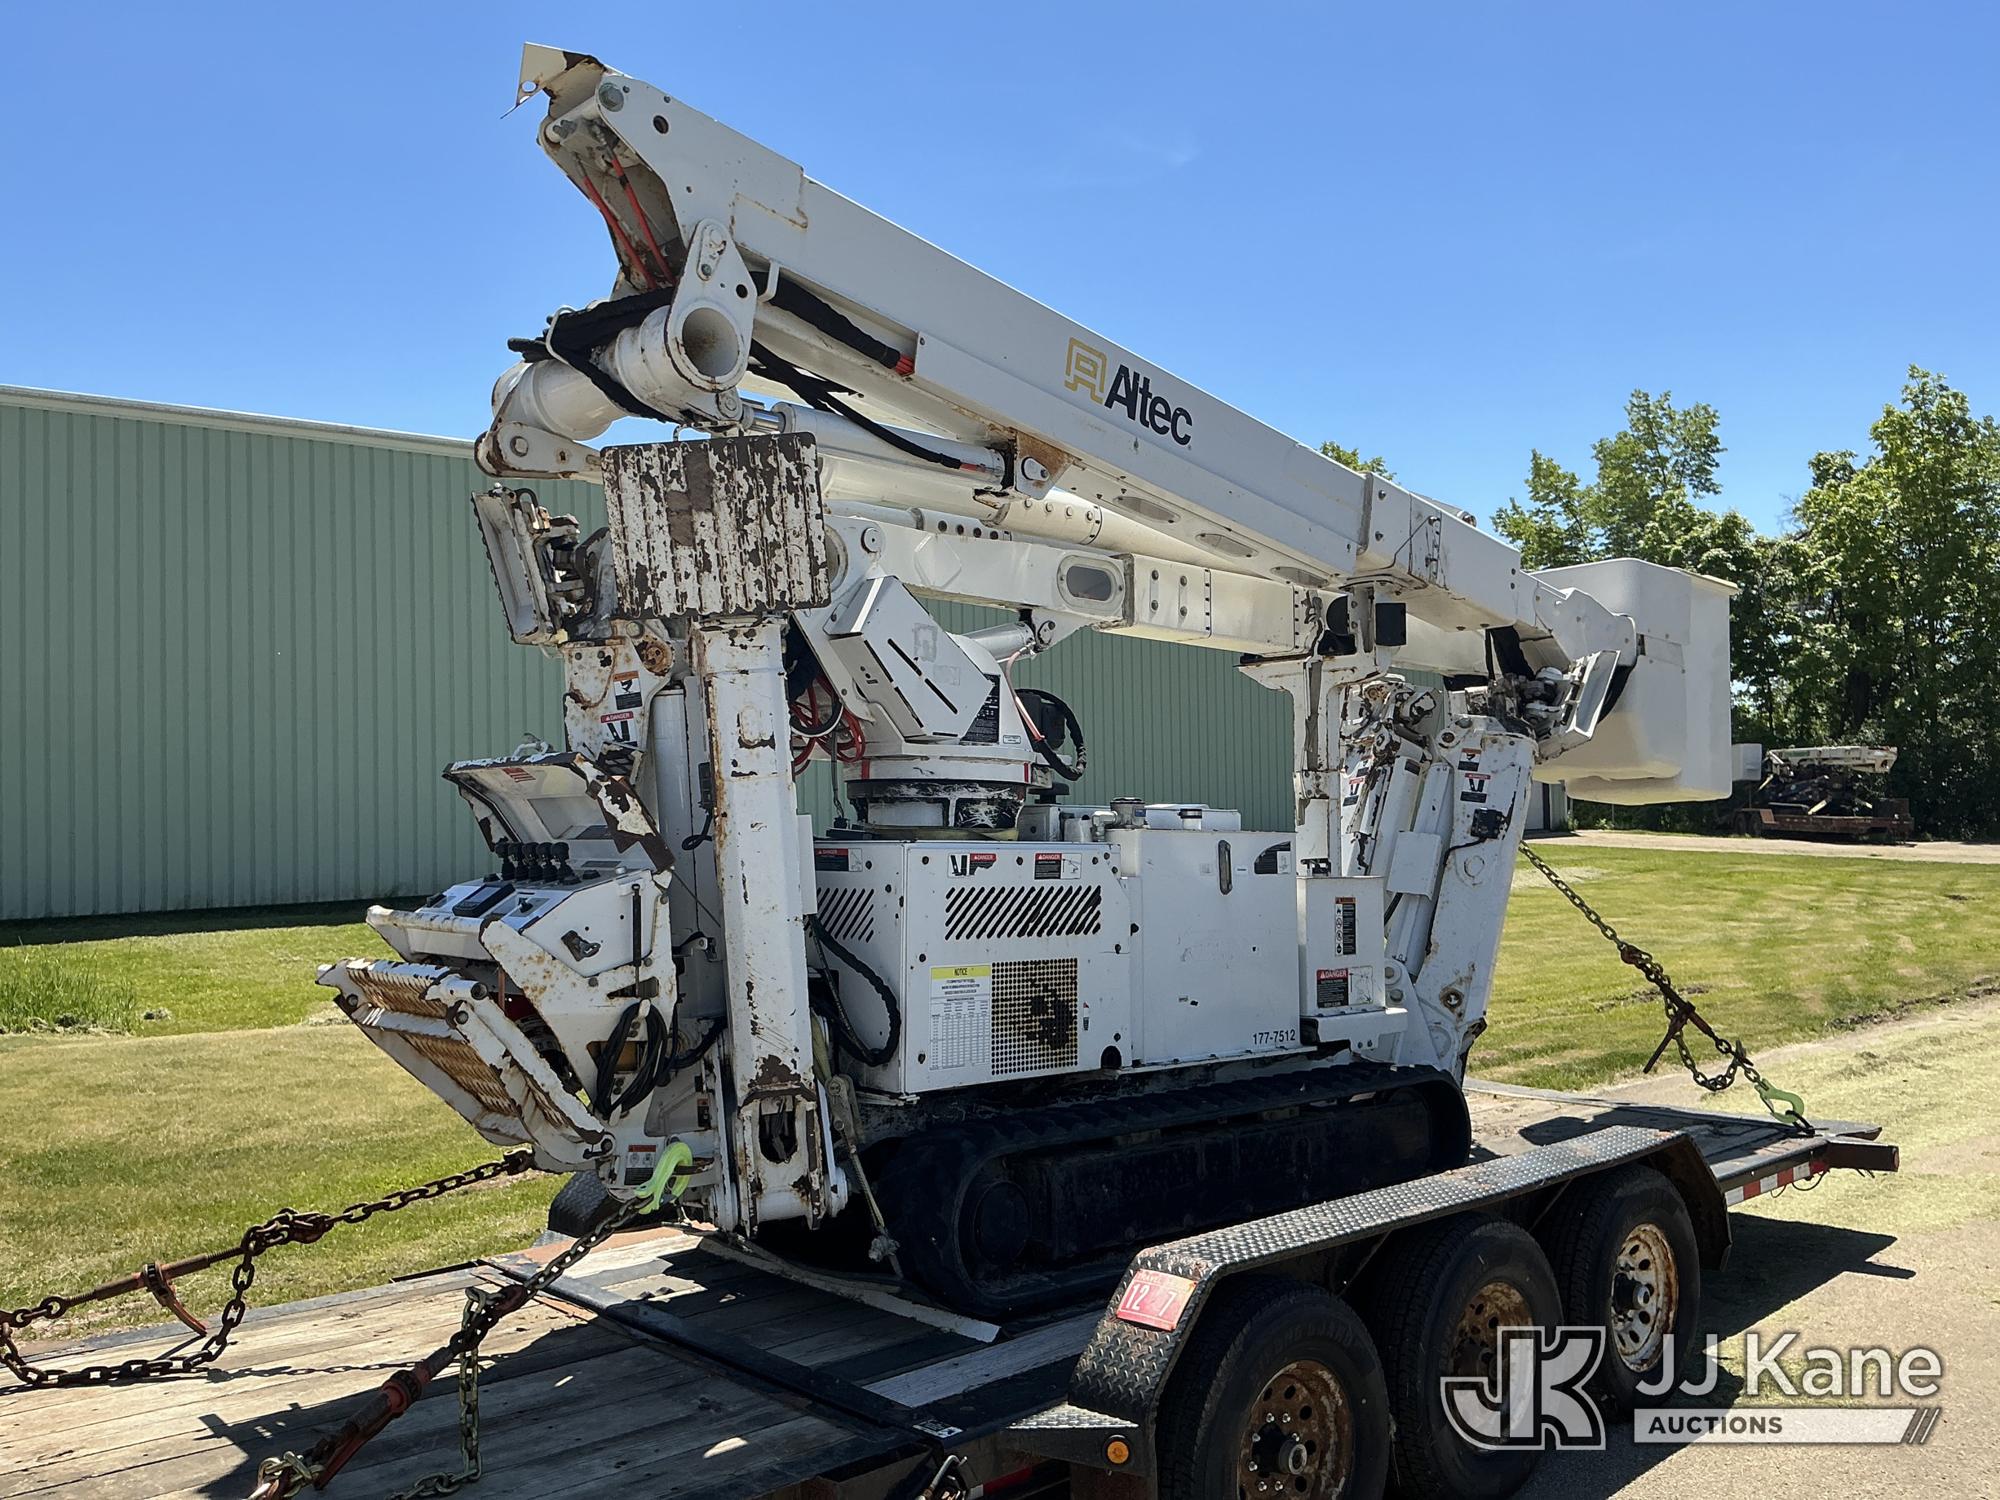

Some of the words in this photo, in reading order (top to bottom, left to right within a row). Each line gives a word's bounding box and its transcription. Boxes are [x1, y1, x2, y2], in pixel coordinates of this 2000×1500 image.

[1104, 364, 1193, 446] Altec
[1325, 969, 1347, 978] DANGER
[1253, 1029, 1296, 1044] 177-7512
[1125, 1283, 1151, 1311] 12
